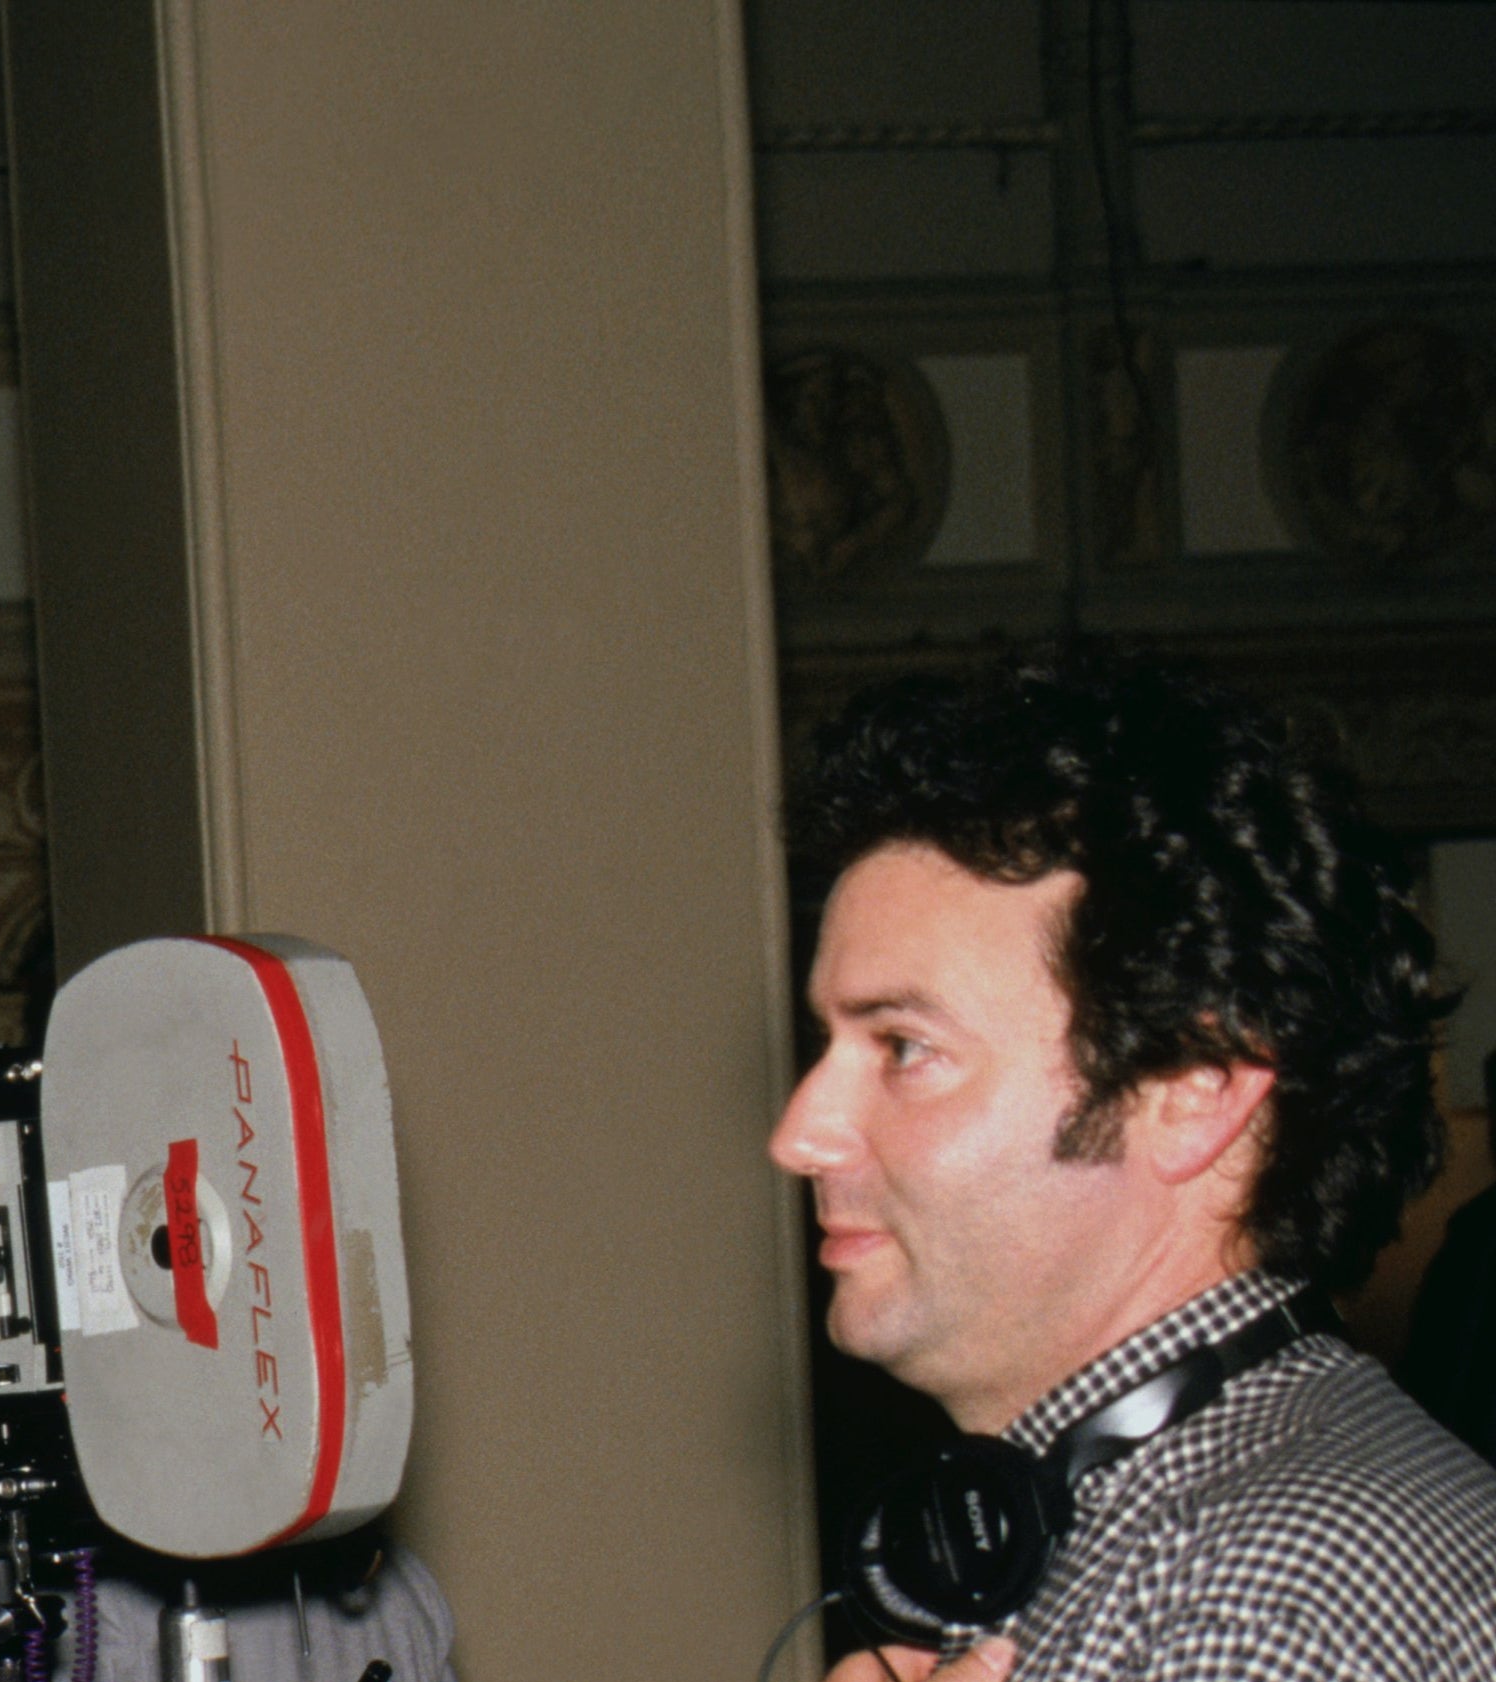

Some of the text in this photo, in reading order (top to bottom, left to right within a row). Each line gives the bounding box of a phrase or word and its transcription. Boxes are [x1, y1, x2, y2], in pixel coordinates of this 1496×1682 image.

[171, 1178, 199, 1268] 5298
[229, 1039, 283, 1440] PANAFLEX
[964, 1489, 992, 1551] SONY
